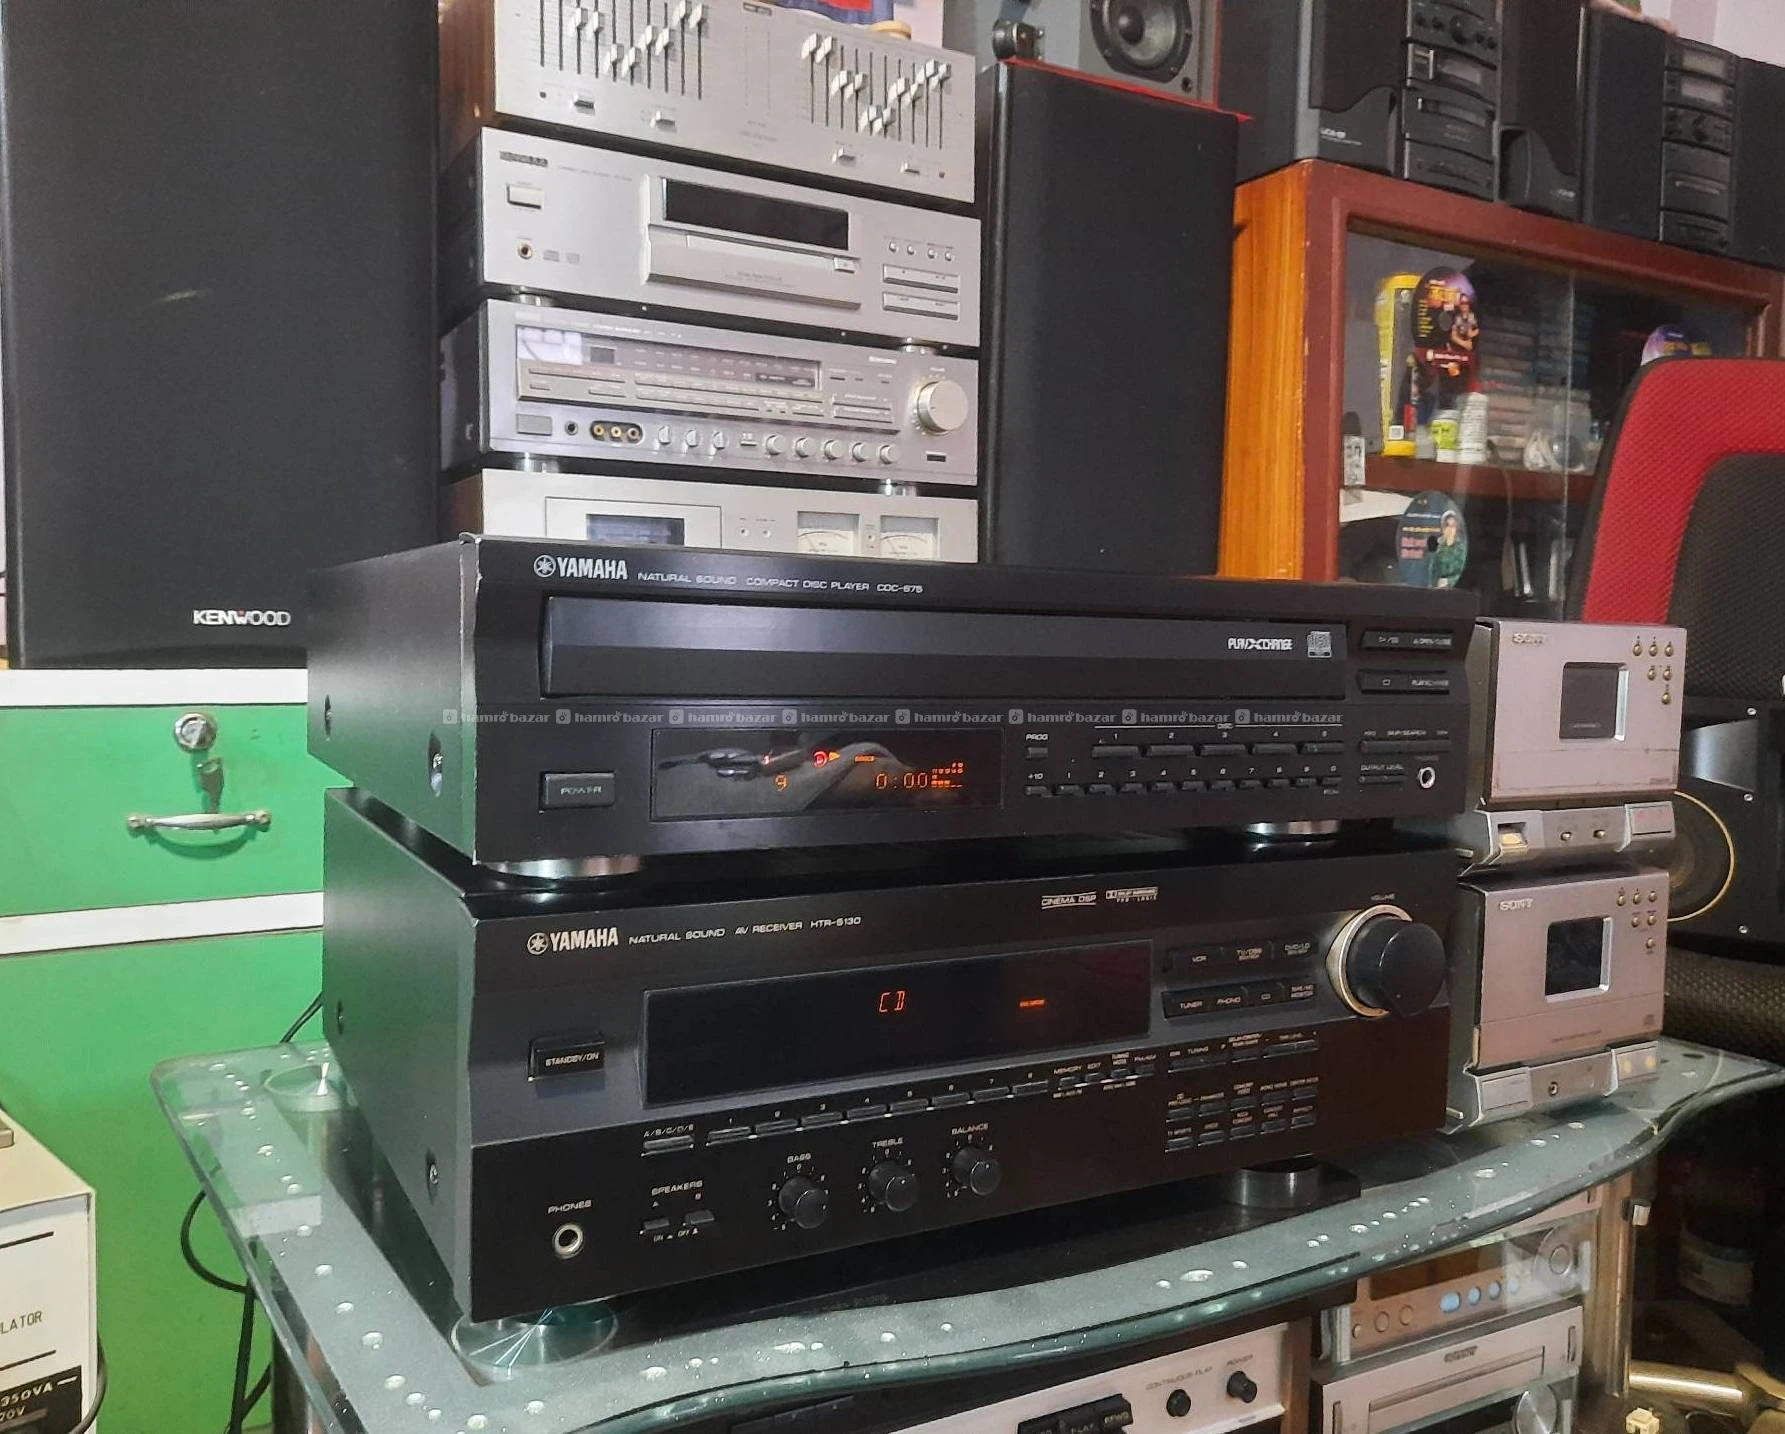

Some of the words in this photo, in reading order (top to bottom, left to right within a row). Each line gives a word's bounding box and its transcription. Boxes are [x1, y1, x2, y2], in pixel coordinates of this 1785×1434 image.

[557, 556, 628, 581] YAMAHA
[637, 572, 692, 583] NATURAL
[696, 574, 737, 585] SOUND
[745, 577, 800, 588] COMPACT
[802, 580, 828, 589] DISC
[830, 581, 870, 591] PLAYER
[193, 609, 292, 626] KENWOOD
[1041, 896, 1075, 906] CINEMA
[550, 927, 619, 952] YAMAHA
[629, 933, 681, 945] NATURAL
[685, 928, 726, 940] SOUND
[735, 926, 749, 935] AV
[752, 921, 803, 934] RECEIVER
[878, 990, 907, 1014] CD
[1180, 1001, 1203, 1009] TUNER
[545, 1053, 600, 1067] STANDBY/ON
[952, 1123, 989, 1135] BALANCE
[872, 1137, 903, 1148] TREBLE
[787, 1153, 811, 1164] BASS
[651, 1180, 703, 1196] SPEAKERS
[548, 1200, 592, 1214] PHONES
